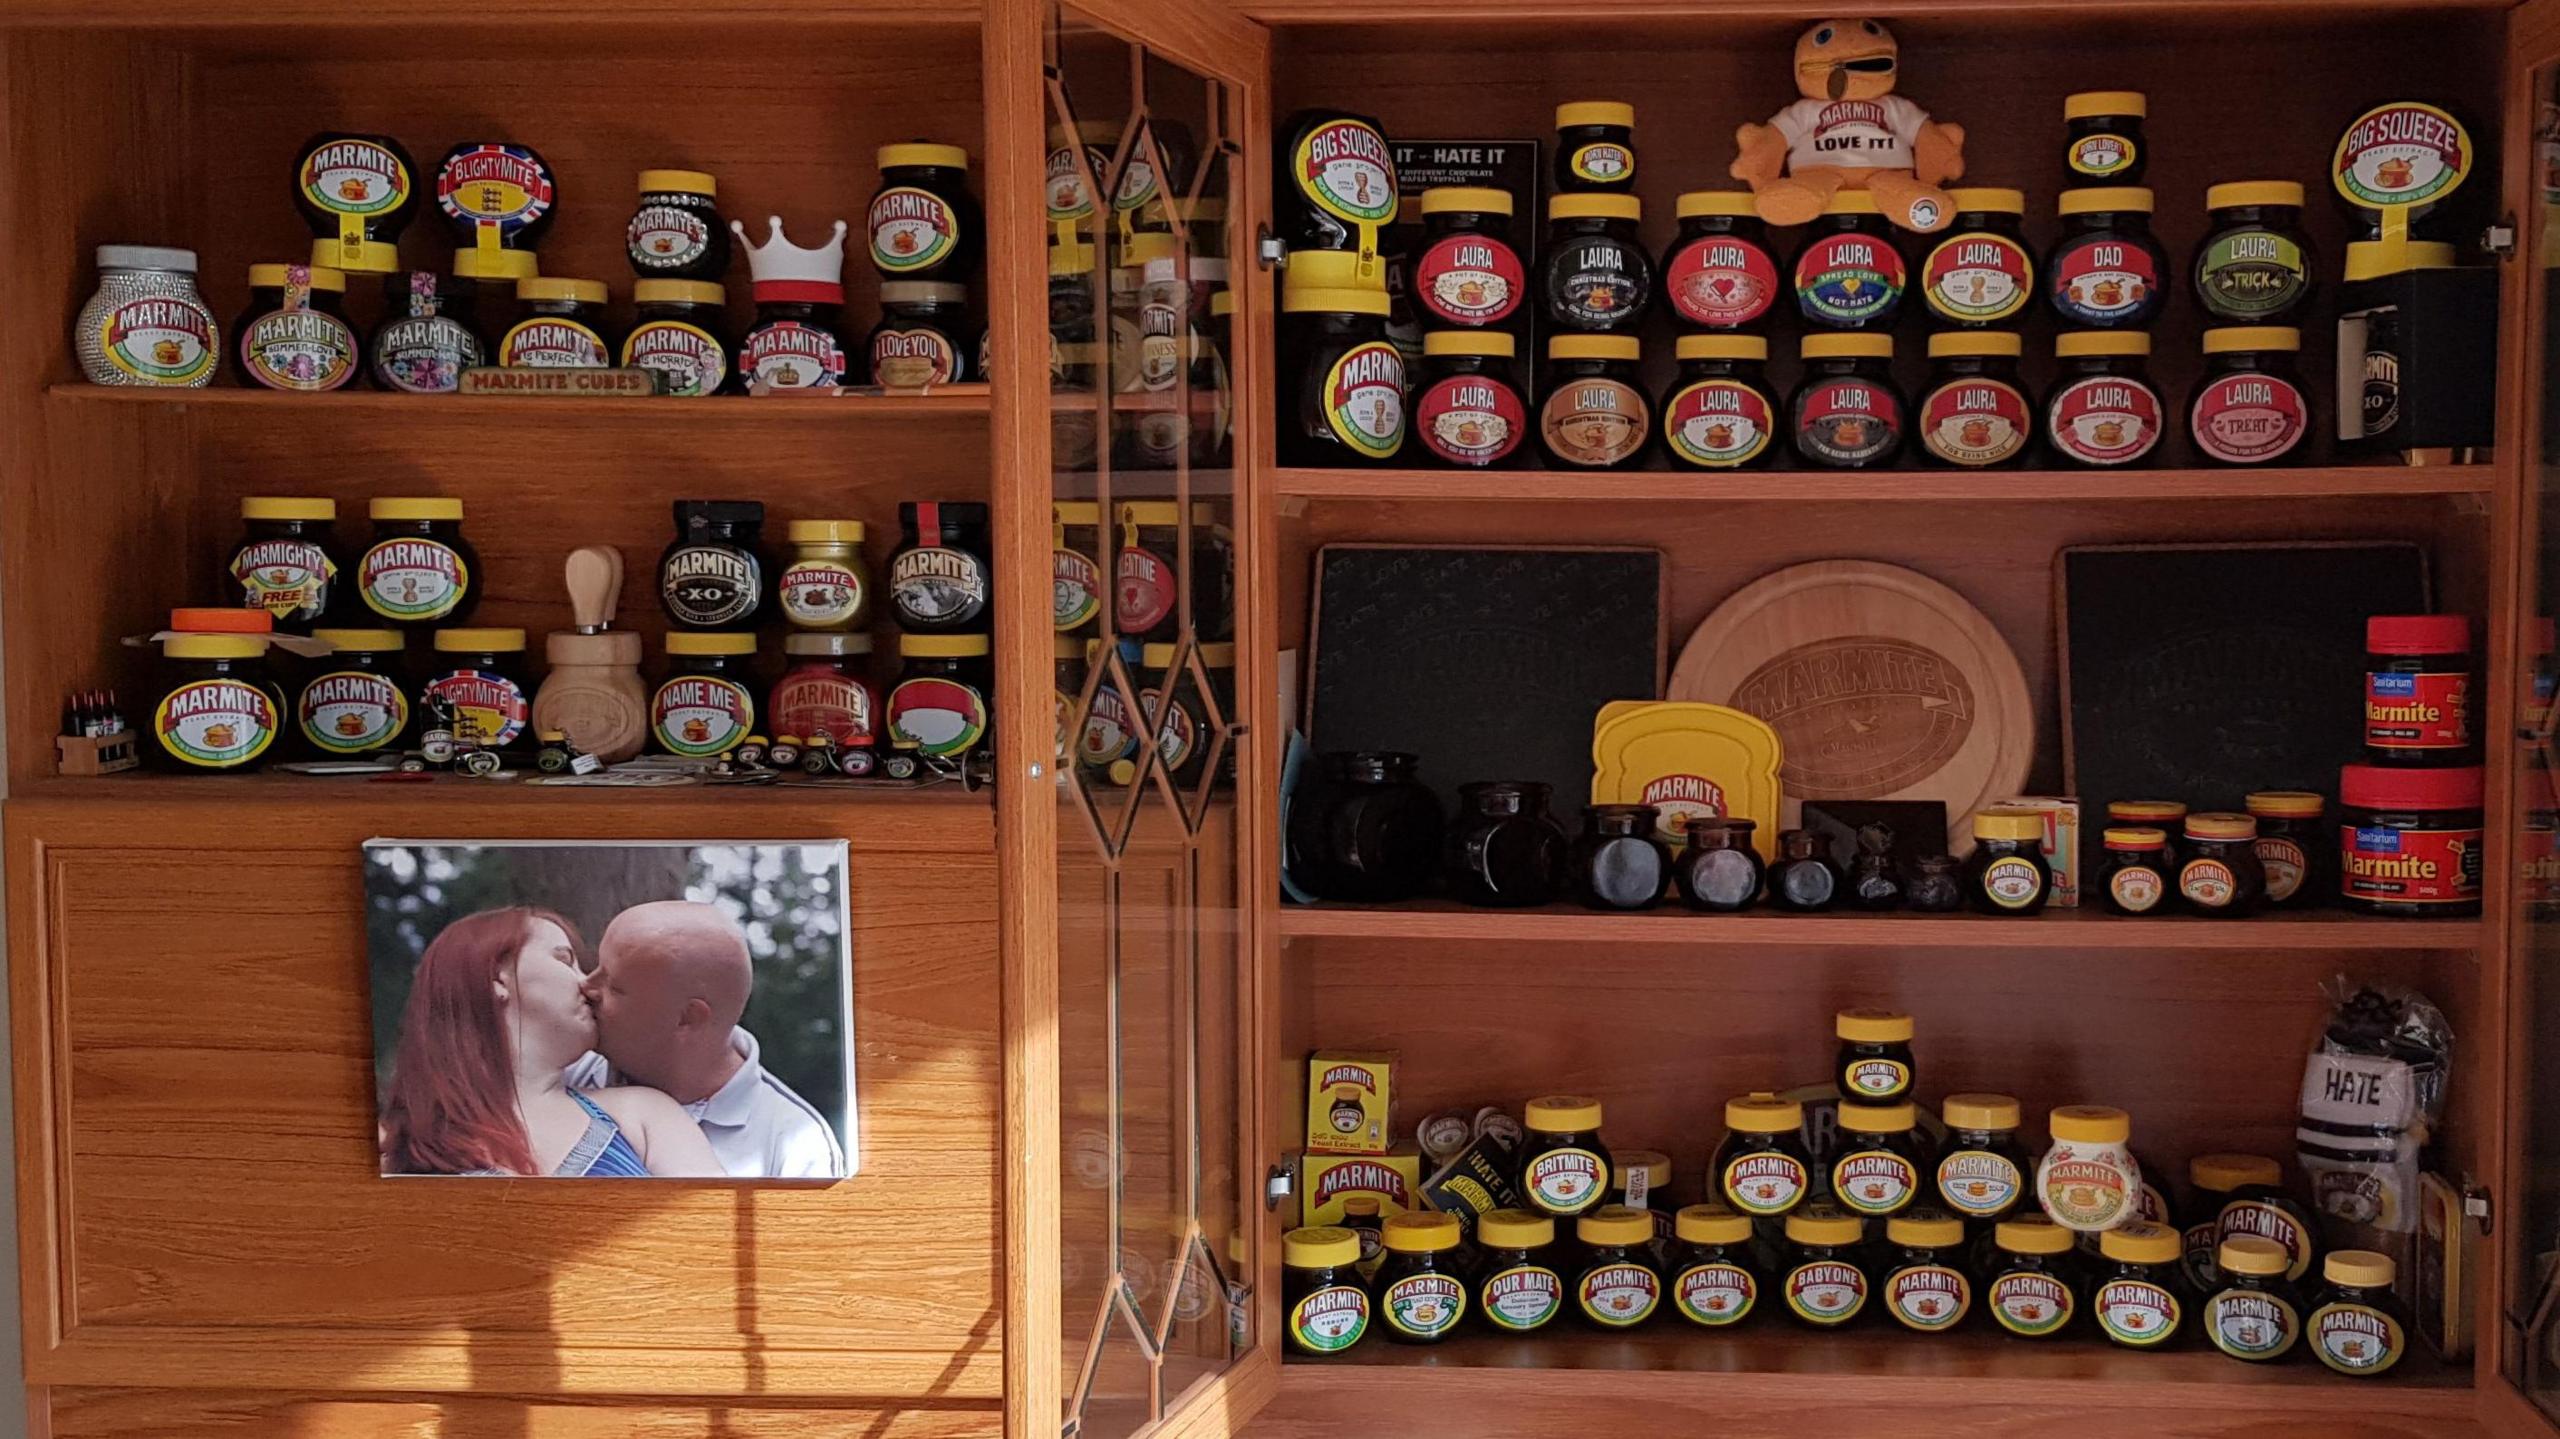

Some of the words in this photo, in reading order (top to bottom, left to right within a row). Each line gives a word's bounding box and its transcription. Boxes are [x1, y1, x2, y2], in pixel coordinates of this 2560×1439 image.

[1815, 137, 1861, 151] LOVE
[1869, 138, 1894, 149] IT!
[2348, 119, 2376, 156] BIG
[2377, 111, 2457, 152] SQUEEZE
[1312, 131, 1338, 163] BIG
[1434, 149, 1482, 163] HATE
[1487, 149, 1505, 164] IT
[314, 143, 397, 177] MARMITE
[455, 156, 533, 185] BLIGHTYMITE
[1449, 169, 1494, 177] CHOCOLATE
[873, 193, 940, 223] MARMITE
[1454, 247, 1493, 270] LAURA
[1580, 248, 1623, 271] LAURA
[1703, 248, 1745, 269] LAURA
[1828, 245, 1874, 267] LAURA
[1957, 244, 2002, 267] LAURA
[2094, 247, 2122, 267] DAD
[2230, 237, 2278, 260] LAURA
[1821, 271, 1855, 281] SPREAD
[1857, 271, 1879, 281] LOVE
[2232, 271, 2270, 290] TRICK
[1828, 295, 1846, 307] NOT
[258, 316, 345, 348] MARMITE
[387, 323, 472, 353] MARMITE
[515, 326, 592, 352] MARMITE
[635, 330, 708, 356] MARMITE
[753, 330, 826, 358] MA'AMITE
[881, 335, 910, 357] LOVE
[911, 336, 938, 358] YOU
[535, 352, 576, 365] PERFECT
[653, 355, 694, 367] HORRID
[578, 371, 640, 389] CUBES
[1451, 387, 1495, 410] LAURA
[1574, 389, 1617, 410] LAURA
[1700, 390, 1740, 412] LAURA
[1831, 388, 1871, 411] LAURA
[1957, 389, 1997, 411] LAURA
[2086, 387, 2132, 411] LAURA
[2225, 383, 2273, 406] LAURA
[2227, 417, 2270, 435] TREAT
[242, 543, 321, 571] MARMIGHTY
[370, 544, 455, 576] MARMITE
[669, 552, 744, 580] MARMITE
[897, 553, 971, 582] MARMITE
[787, 571, 849, 586] MARMITE
[263, 590, 301, 602] FREE
[309, 678, 391, 706] MARMITE
[1750, 650, 1942, 720] MARMITE
[2373, 675, 2414, 688] Sanitarium
[170, 686, 262, 716] MARMITE
[663, 682, 704, 708] NAME
[709, 683, 734, 709] ME
[784, 682, 860, 713] MARMITE
[1648, 776, 1721, 804] MARMITE
[2356, 830, 2398, 845] Sanitarium
[1990, 863, 2034, 880] MARMITE
[2119, 870, 2155, 884] MARMITE
[2185, 864, 2228, 883] MARMITE
[2342, 852, 2438, 880] Marmite
[1325, 1067, 1374, 1088] MARMITE
[1856, 1063, 1898, 1077] MARMITE
[2324, 1068, 2381, 1106] HATE
[1537, 1154, 1594, 1177] BRITMITE
[1737, 1158, 1796, 1178] MARMITE
[1844, 1157, 1906, 1179] MARMITE
[1946, 1157, 2014, 1181] MARMITE
[2053, 1164, 2113, 1184] MARMITE
[1322, 1165, 1401, 1194] MARMITE
[2223, 1208, 2296, 1248] MARMITE
[1492, 1273, 1520, 1297] OUR
[1525, 1272, 1554, 1292] MATE
[1591, 1269, 1651, 1289] MARMITE
[1686, 1269, 1746, 1289] MARMITE
[1798, 1267, 1832, 1286] BABY
[1832, 1268, 1858, 1286] ONE
[1899, 1272, 1959, 1294] MARMITE
[1394, 1279, 1457, 1299] MARMITE
[2000, 1277, 2062, 1300] MARMITE
[2105, 1283, 2169, 1308] MARMITE
[1304, 1292, 1362, 1317] MARMITE
[2218, 1297, 2282, 1323] MARMITE
[2322, 1311, 2388, 1338] MARMITE
